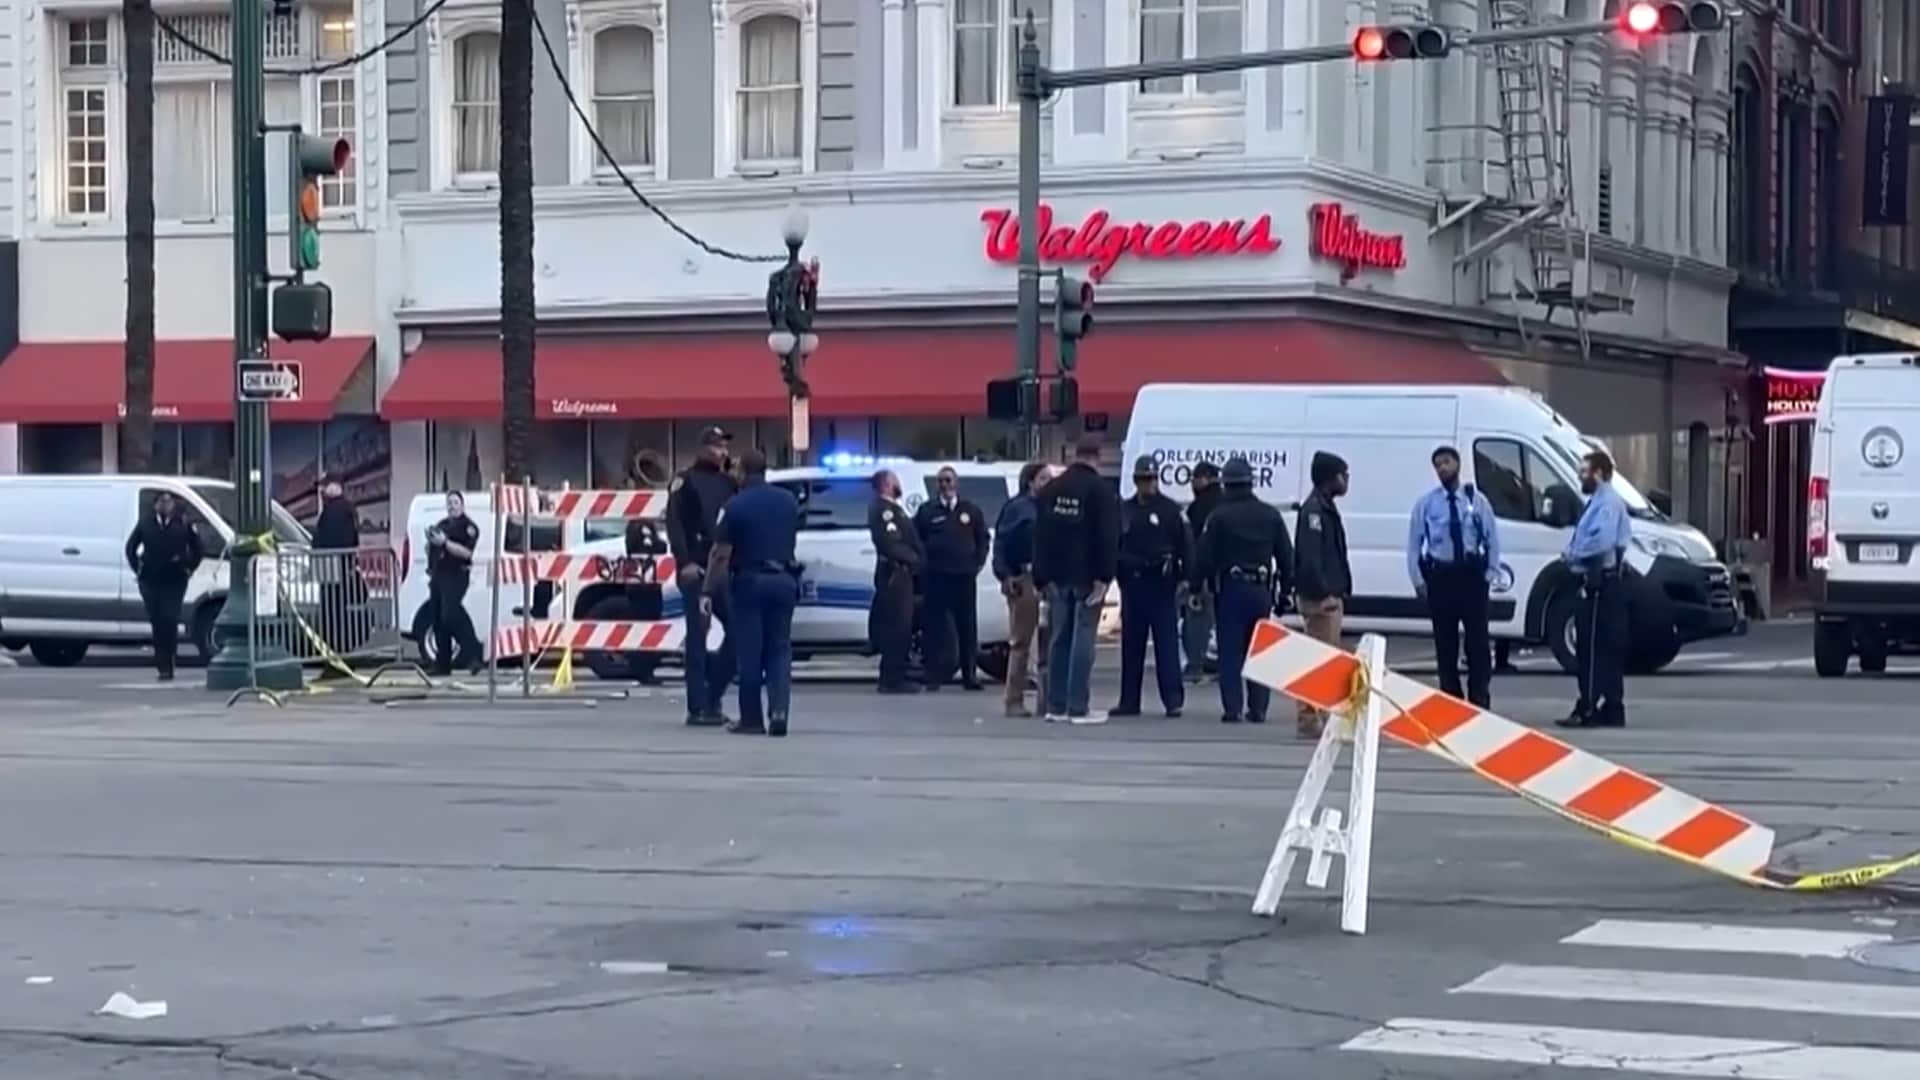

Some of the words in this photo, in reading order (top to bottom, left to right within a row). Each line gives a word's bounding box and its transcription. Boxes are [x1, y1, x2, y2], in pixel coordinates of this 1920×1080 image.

[981, 204, 1281, 284] Walgreens
[552, 398, 618, 417] Walgreens
[1152, 448, 1225, 465] ORLEANS
